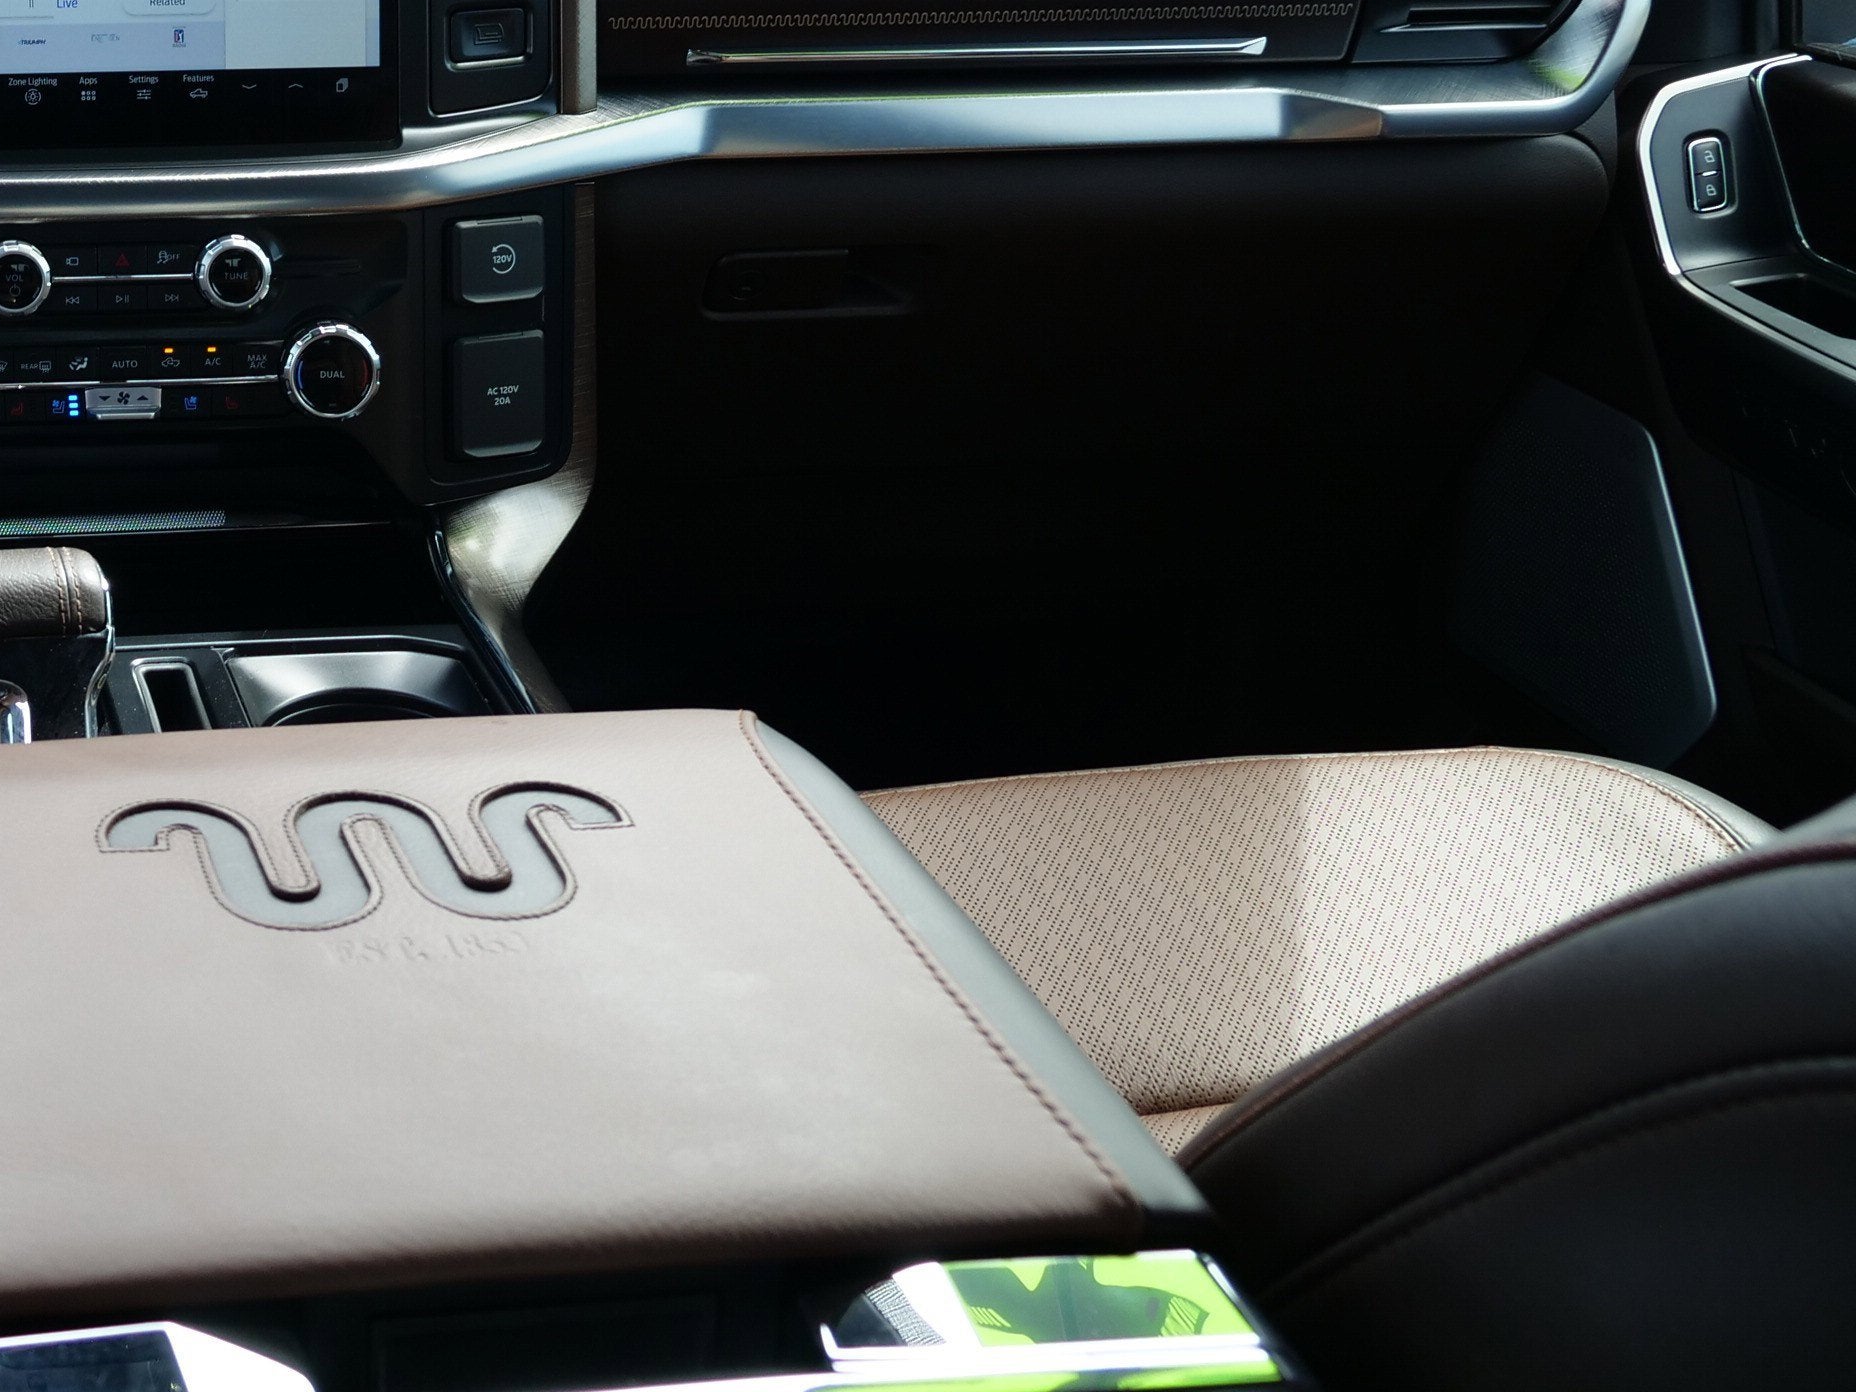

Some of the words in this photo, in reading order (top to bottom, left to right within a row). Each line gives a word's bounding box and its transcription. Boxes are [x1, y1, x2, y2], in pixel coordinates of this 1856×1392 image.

[8, 77, 26, 87] Zone
[27, 77, 58, 88] Lighting
[79, 76, 98, 87] Apps
[128, 74, 159, 86] Settings
[182, 73, 214, 84] Features
[492, 254, 513, 264] 120V
[5, 273, 24, 282] VOL
[223, 271, 249, 281] TUNE
[204, 357, 222, 366] A/C
[247, 354, 268, 362] MAX
[111, 360, 139, 369] AUTO
[319, 370, 345, 379] DUAL
[487, 387, 499, 397] AC
[499, 384, 520, 395] 120V
[494, 397, 511, 406] 20A
